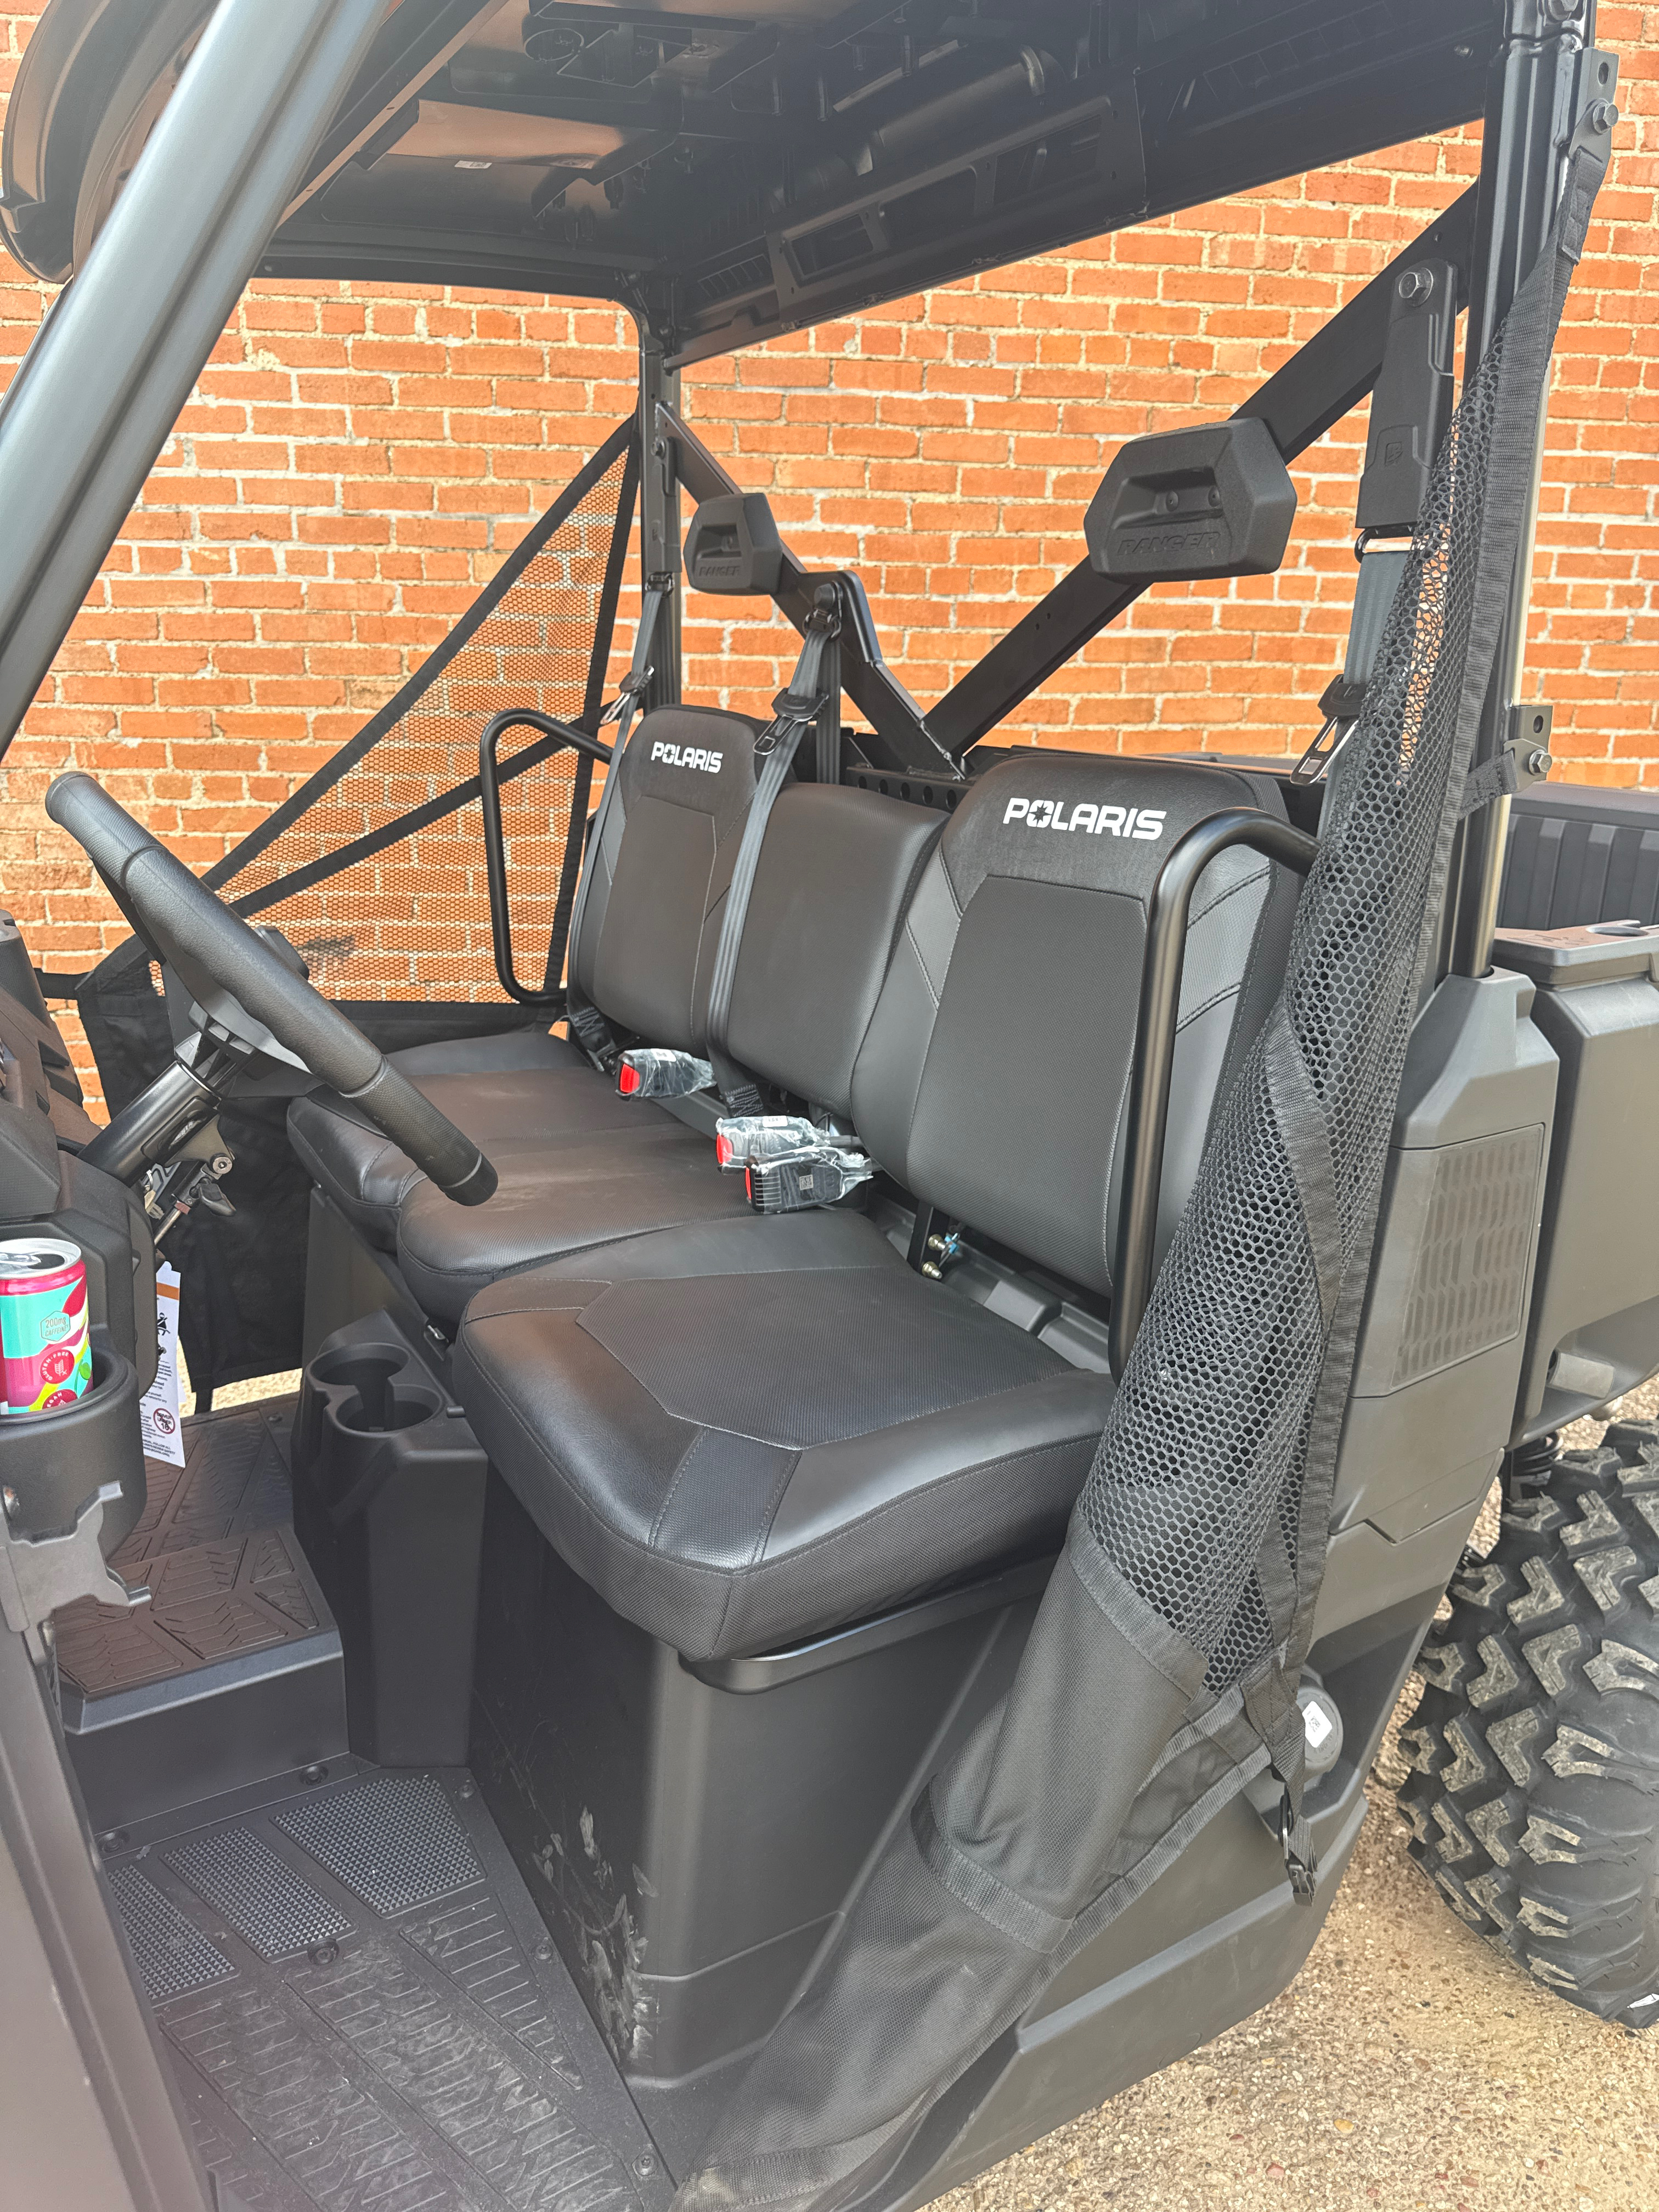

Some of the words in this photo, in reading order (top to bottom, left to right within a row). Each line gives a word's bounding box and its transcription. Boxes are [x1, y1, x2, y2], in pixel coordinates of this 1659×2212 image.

[1117, 531, 1221, 556] RANGER
[699, 566, 741, 576] RANGER
[650, 741, 724, 774] POLARIS
[1003, 797, 1167, 840] POLARIS
[45, 1317, 66, 1328] 200mg
[161, 1423, 170, 1431] 16
